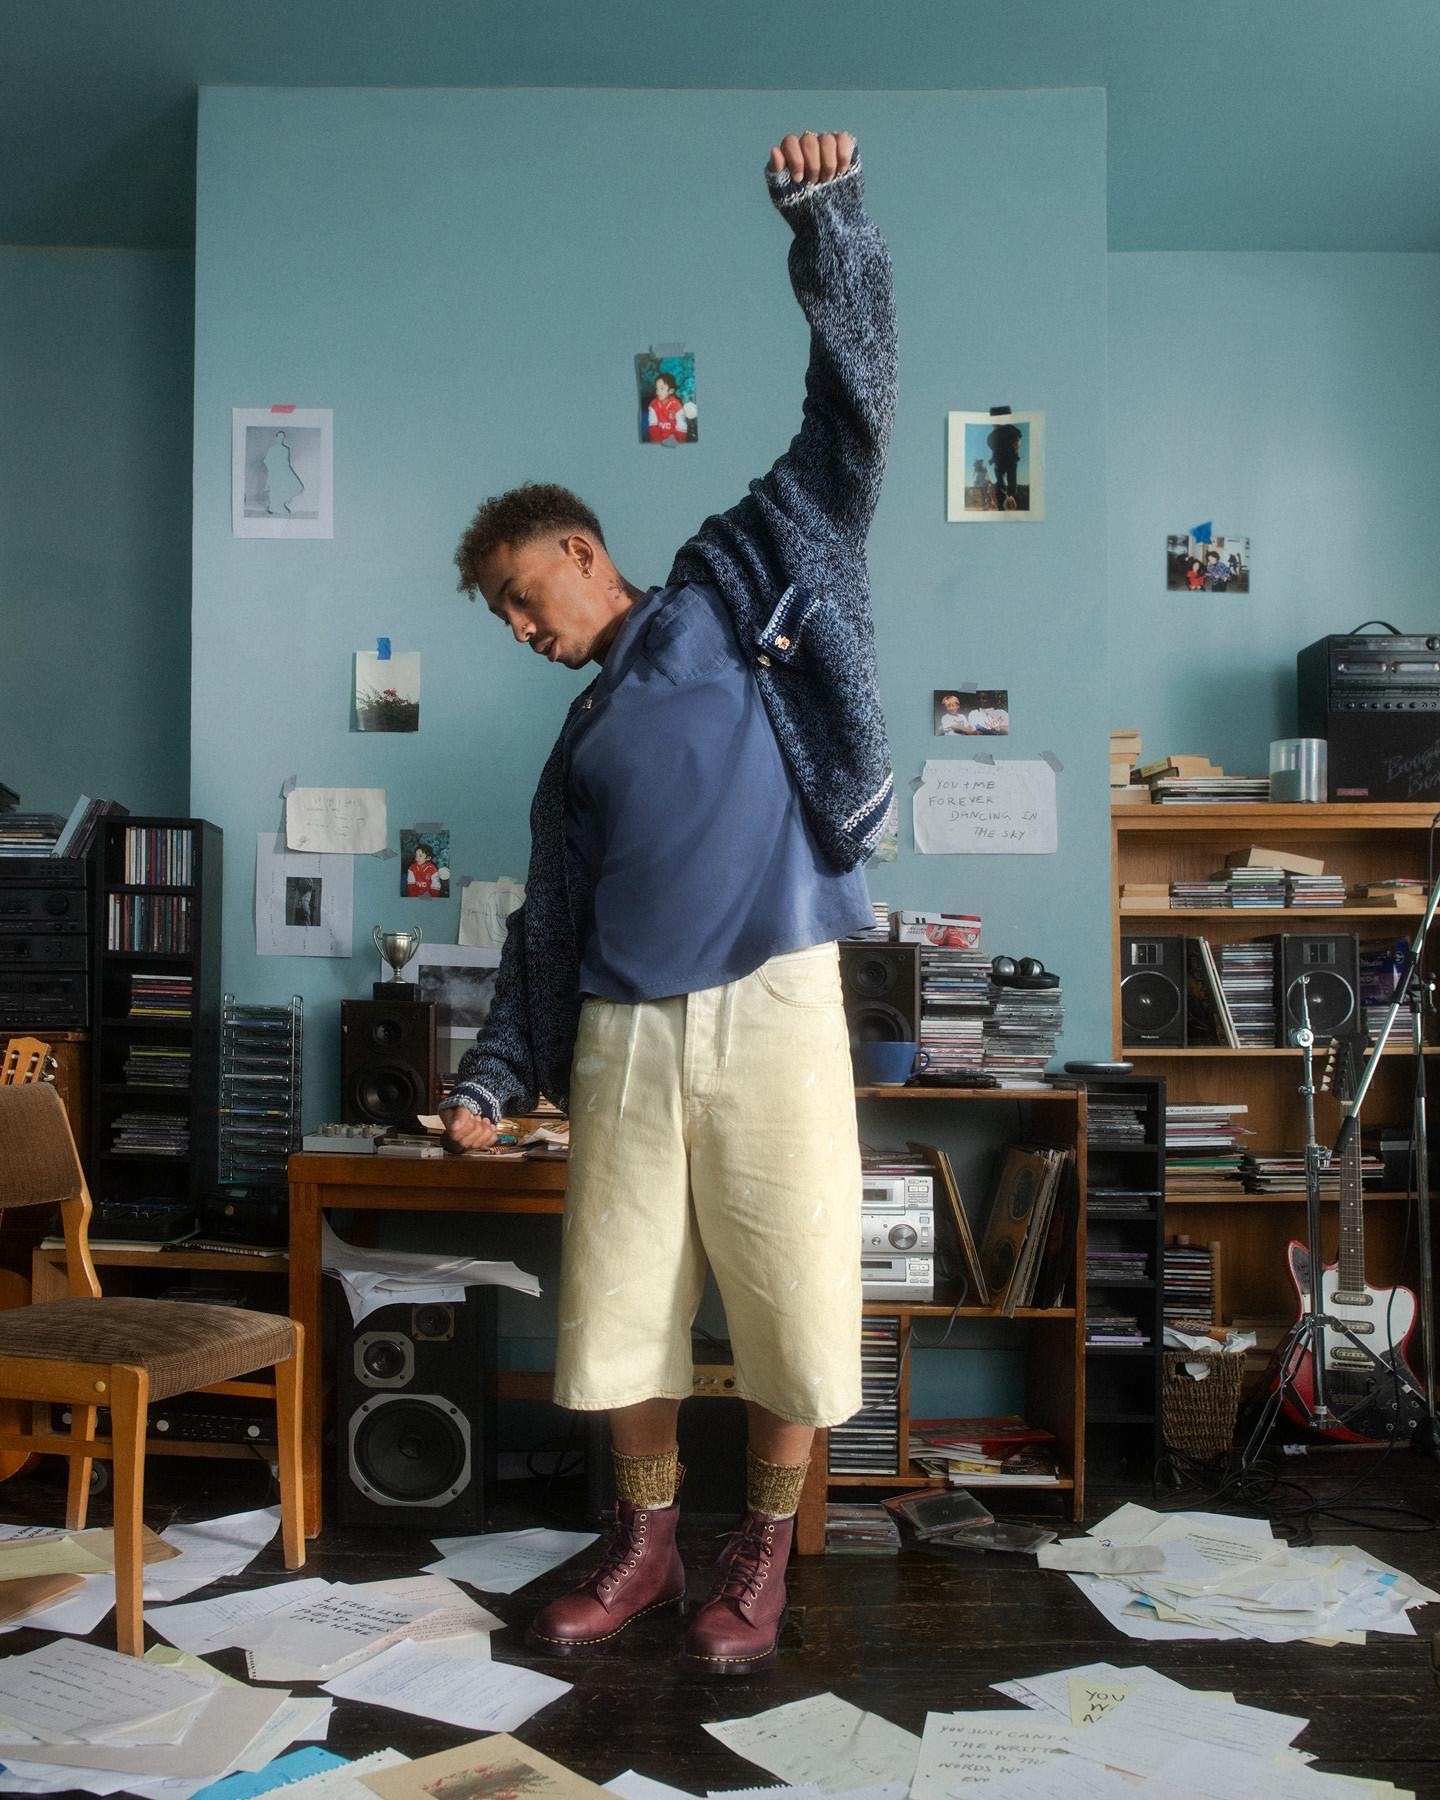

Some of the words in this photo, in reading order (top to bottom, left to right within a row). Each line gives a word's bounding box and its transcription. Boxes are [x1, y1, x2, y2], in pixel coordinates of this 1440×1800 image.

[936, 778, 959, 790] YOU
[973, 780, 995, 790] ME
[928, 795, 994, 808] FOREVER
[949, 809, 1012, 822] DANCING
[1021, 810, 1038, 821] IN
[973, 826, 996, 838] THE
[1001, 829, 1025, 841] SKY
[340, 1600, 375, 1612] FEEL
[1085, 1690, 1126, 1702] YOU
[940, 1725, 965, 1734] YOU
[968, 1728, 1002, 1736] JUST
[949, 1740, 987, 1749] THE
[938, 1762, 991, 1773] WORDS
